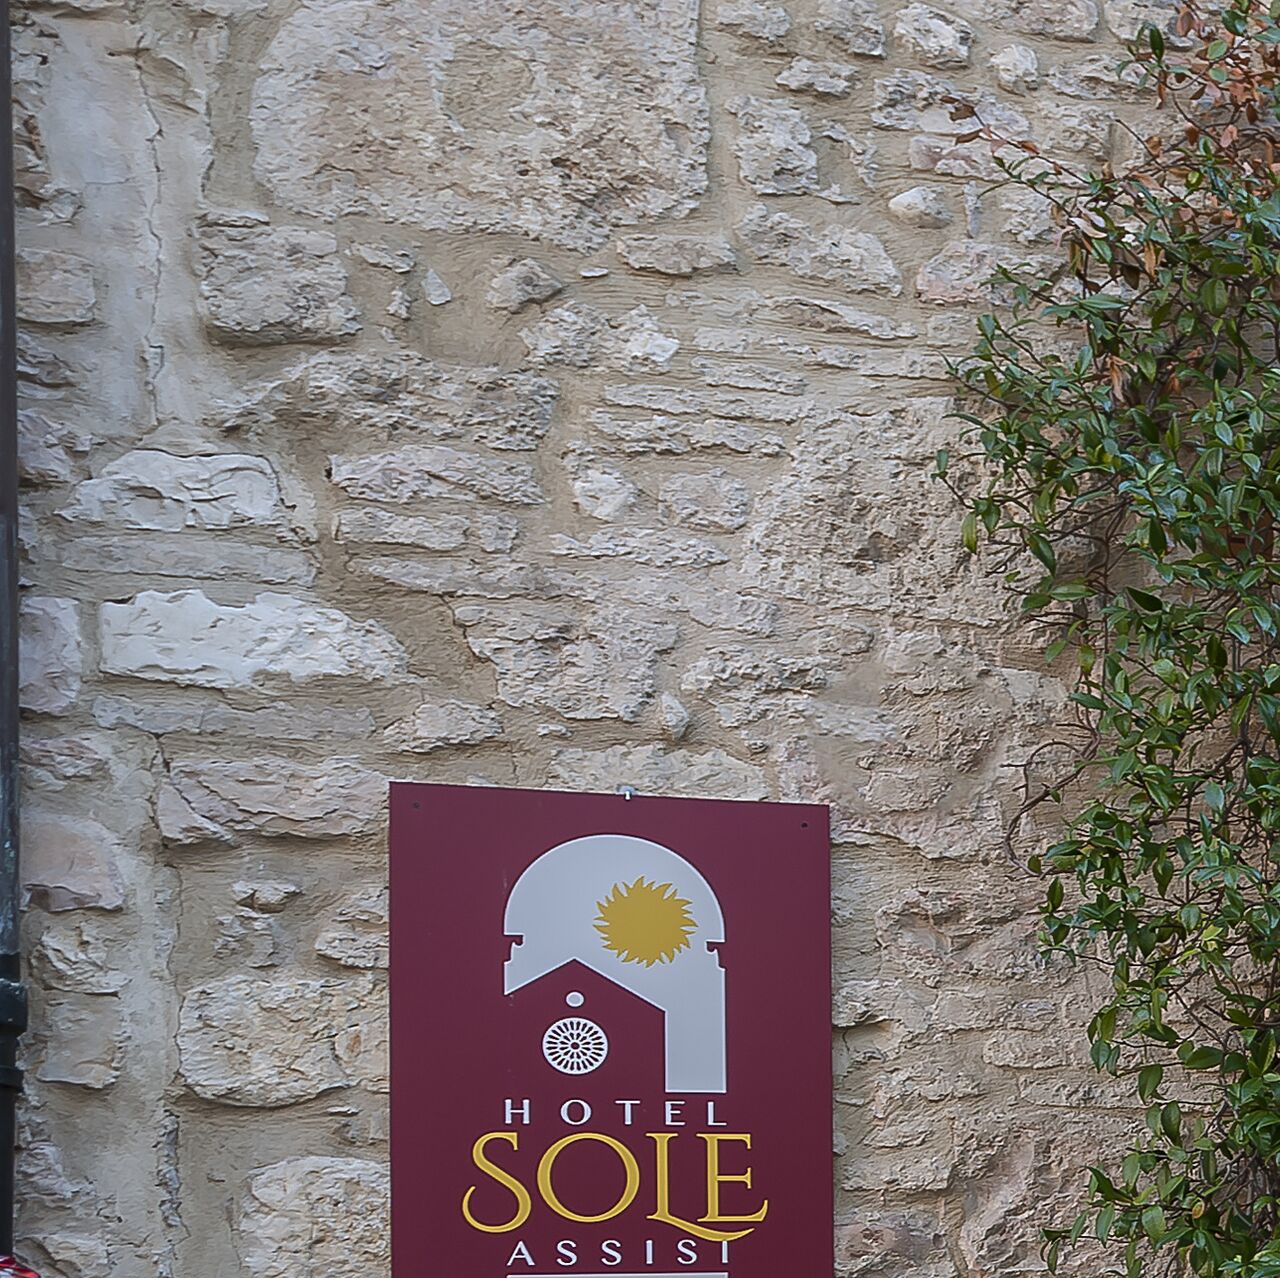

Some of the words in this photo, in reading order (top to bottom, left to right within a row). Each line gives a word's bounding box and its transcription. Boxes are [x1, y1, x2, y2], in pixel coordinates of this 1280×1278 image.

[504, 1099, 728, 1126] HOTEL
[462, 1131, 769, 1241] SOLE
[506, 1240, 728, 1266] ASSISI
